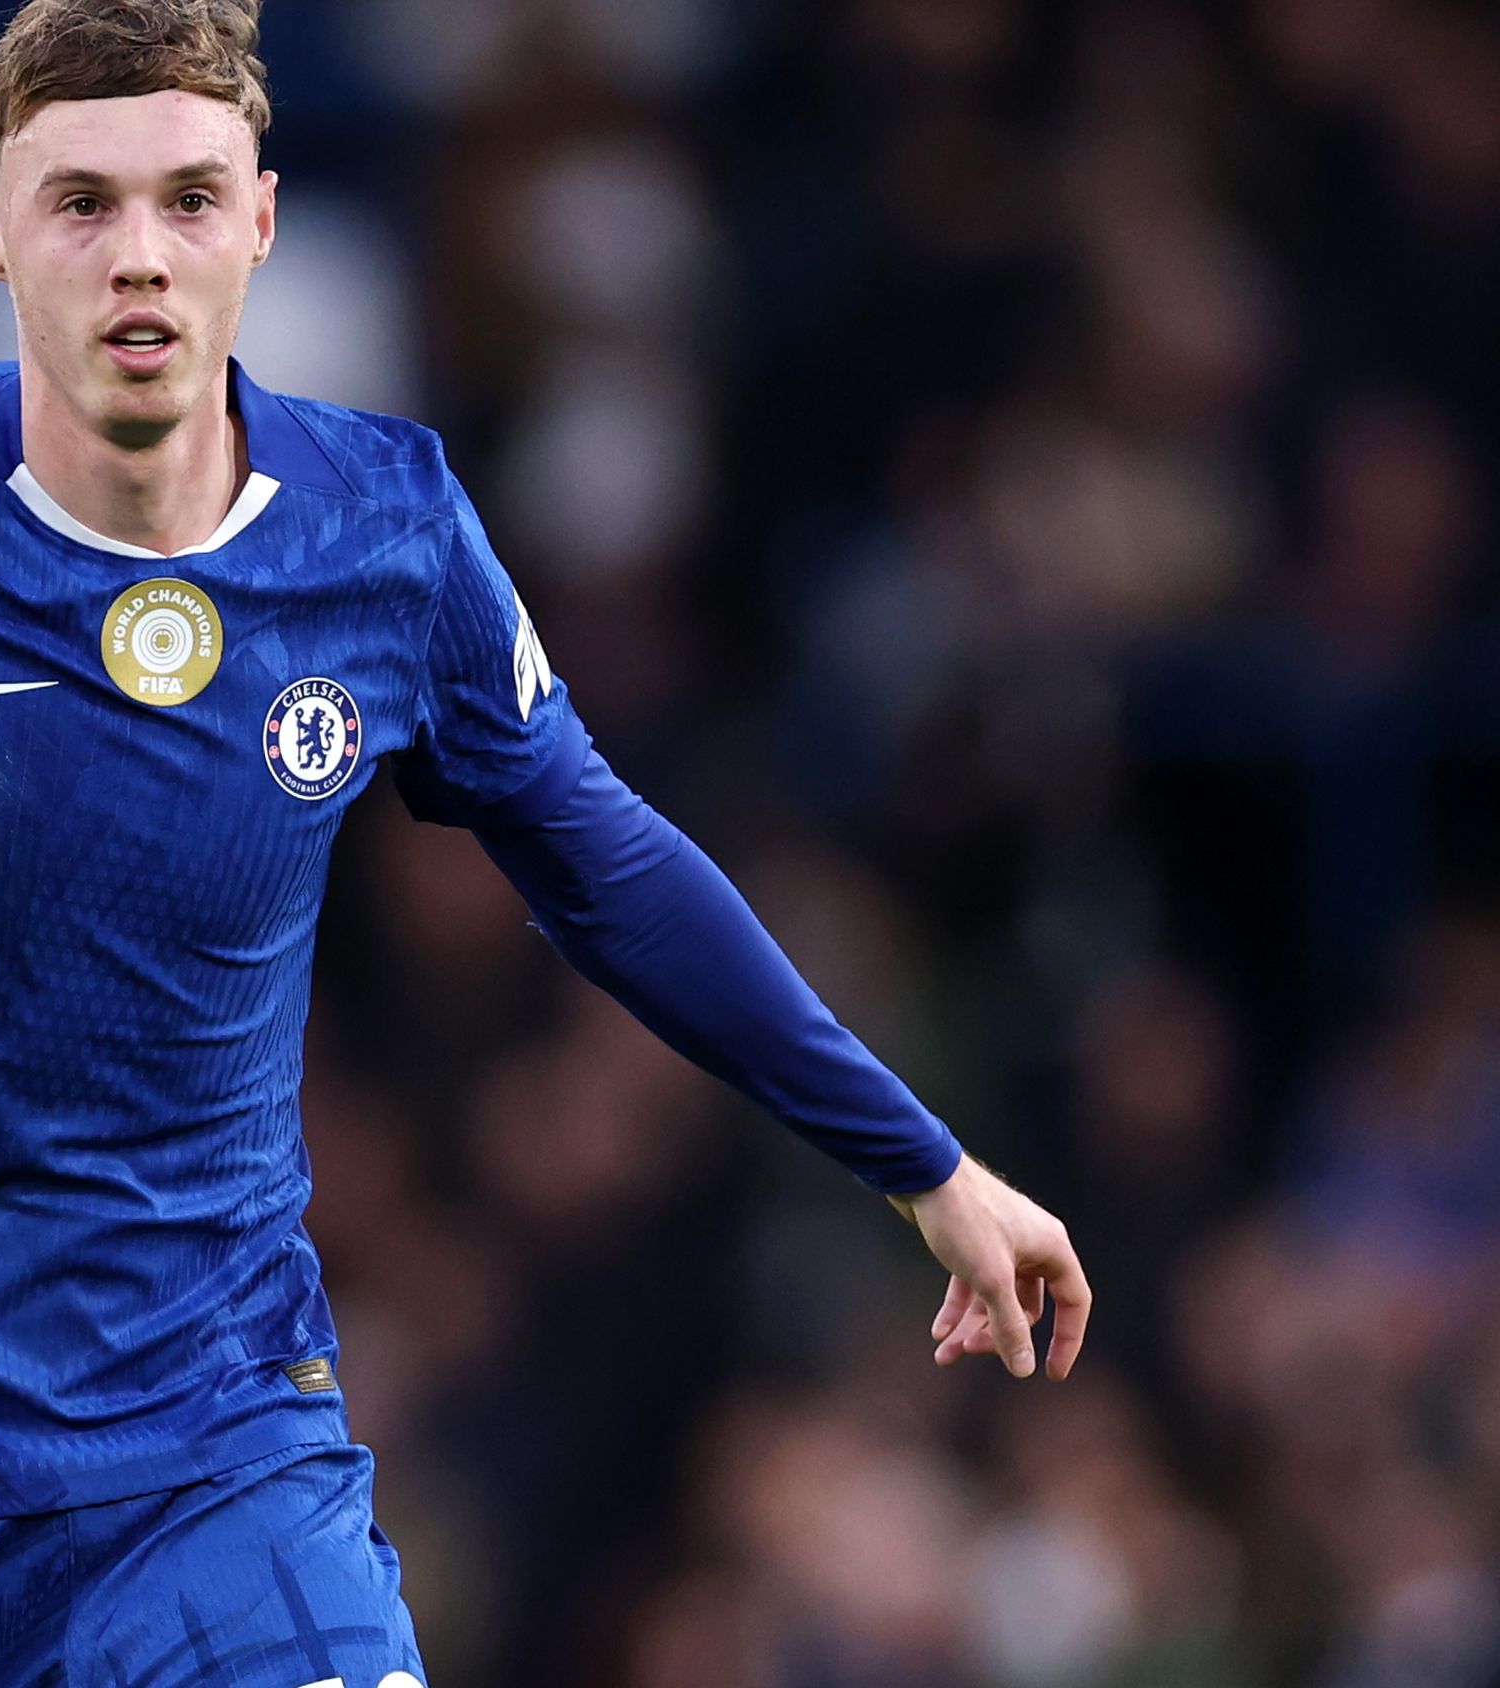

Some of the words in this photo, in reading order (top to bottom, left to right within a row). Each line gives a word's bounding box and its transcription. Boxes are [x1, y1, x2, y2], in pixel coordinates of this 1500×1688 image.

[112, 597, 145, 655] WORLD
[147, 589, 212, 658] CHAMPIONS
[138, 676, 184, 694] FIFA
[282, 683, 345, 708] CHELSEA
[280, 771, 320, 793] FOOTBALL
[323, 769, 343, 789] CLUB
